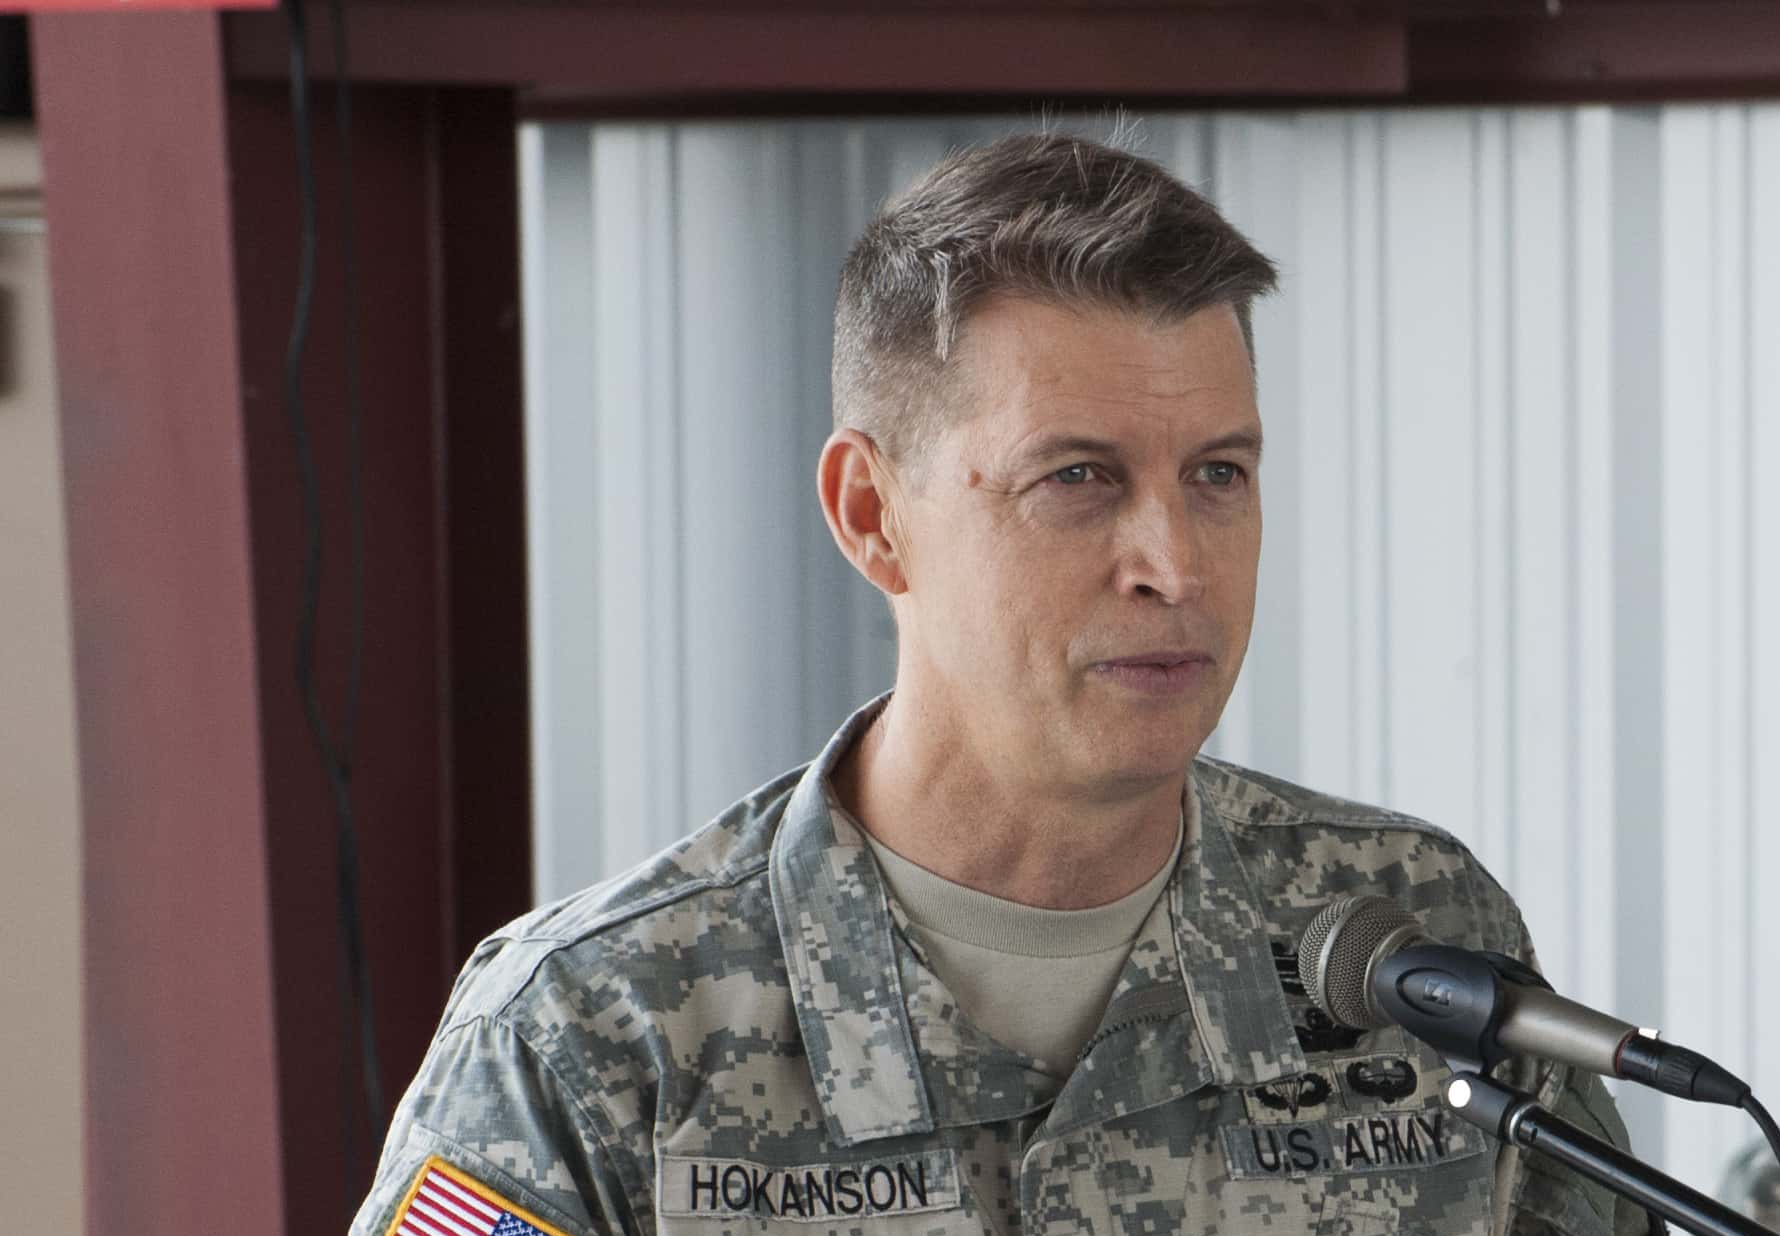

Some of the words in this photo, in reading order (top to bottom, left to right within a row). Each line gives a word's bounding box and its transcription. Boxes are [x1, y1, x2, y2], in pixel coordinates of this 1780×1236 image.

[1252, 1127, 1330, 1173] U.S.
[1345, 1113, 1444, 1167] ARMY
[690, 1162, 928, 1217] HOKANSON
